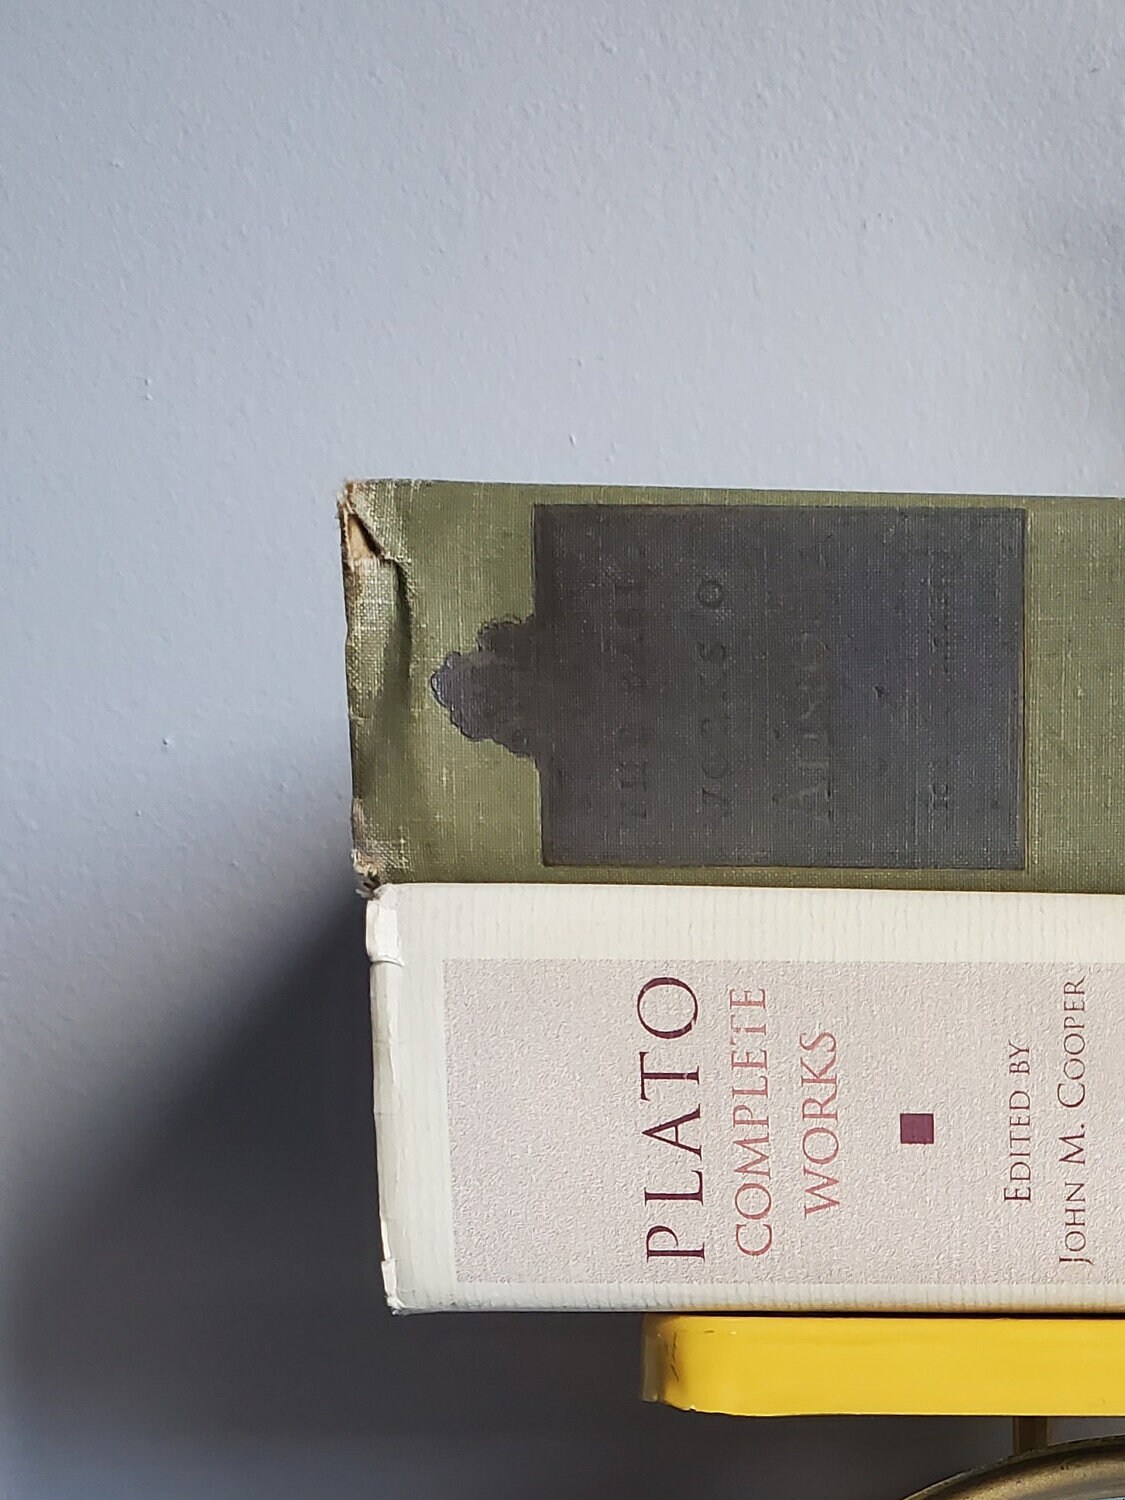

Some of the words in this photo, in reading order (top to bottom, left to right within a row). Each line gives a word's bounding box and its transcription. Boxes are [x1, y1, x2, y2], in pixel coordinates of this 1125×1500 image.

[636, 976, 706, 1263] PLATO
[728, 988, 773, 1257] COMPLETE
[799, 1031, 841, 1220] WORKS
[1008, 1040, 1031, 1075] BY
[1058, 1123, 1086, 1165] M.
